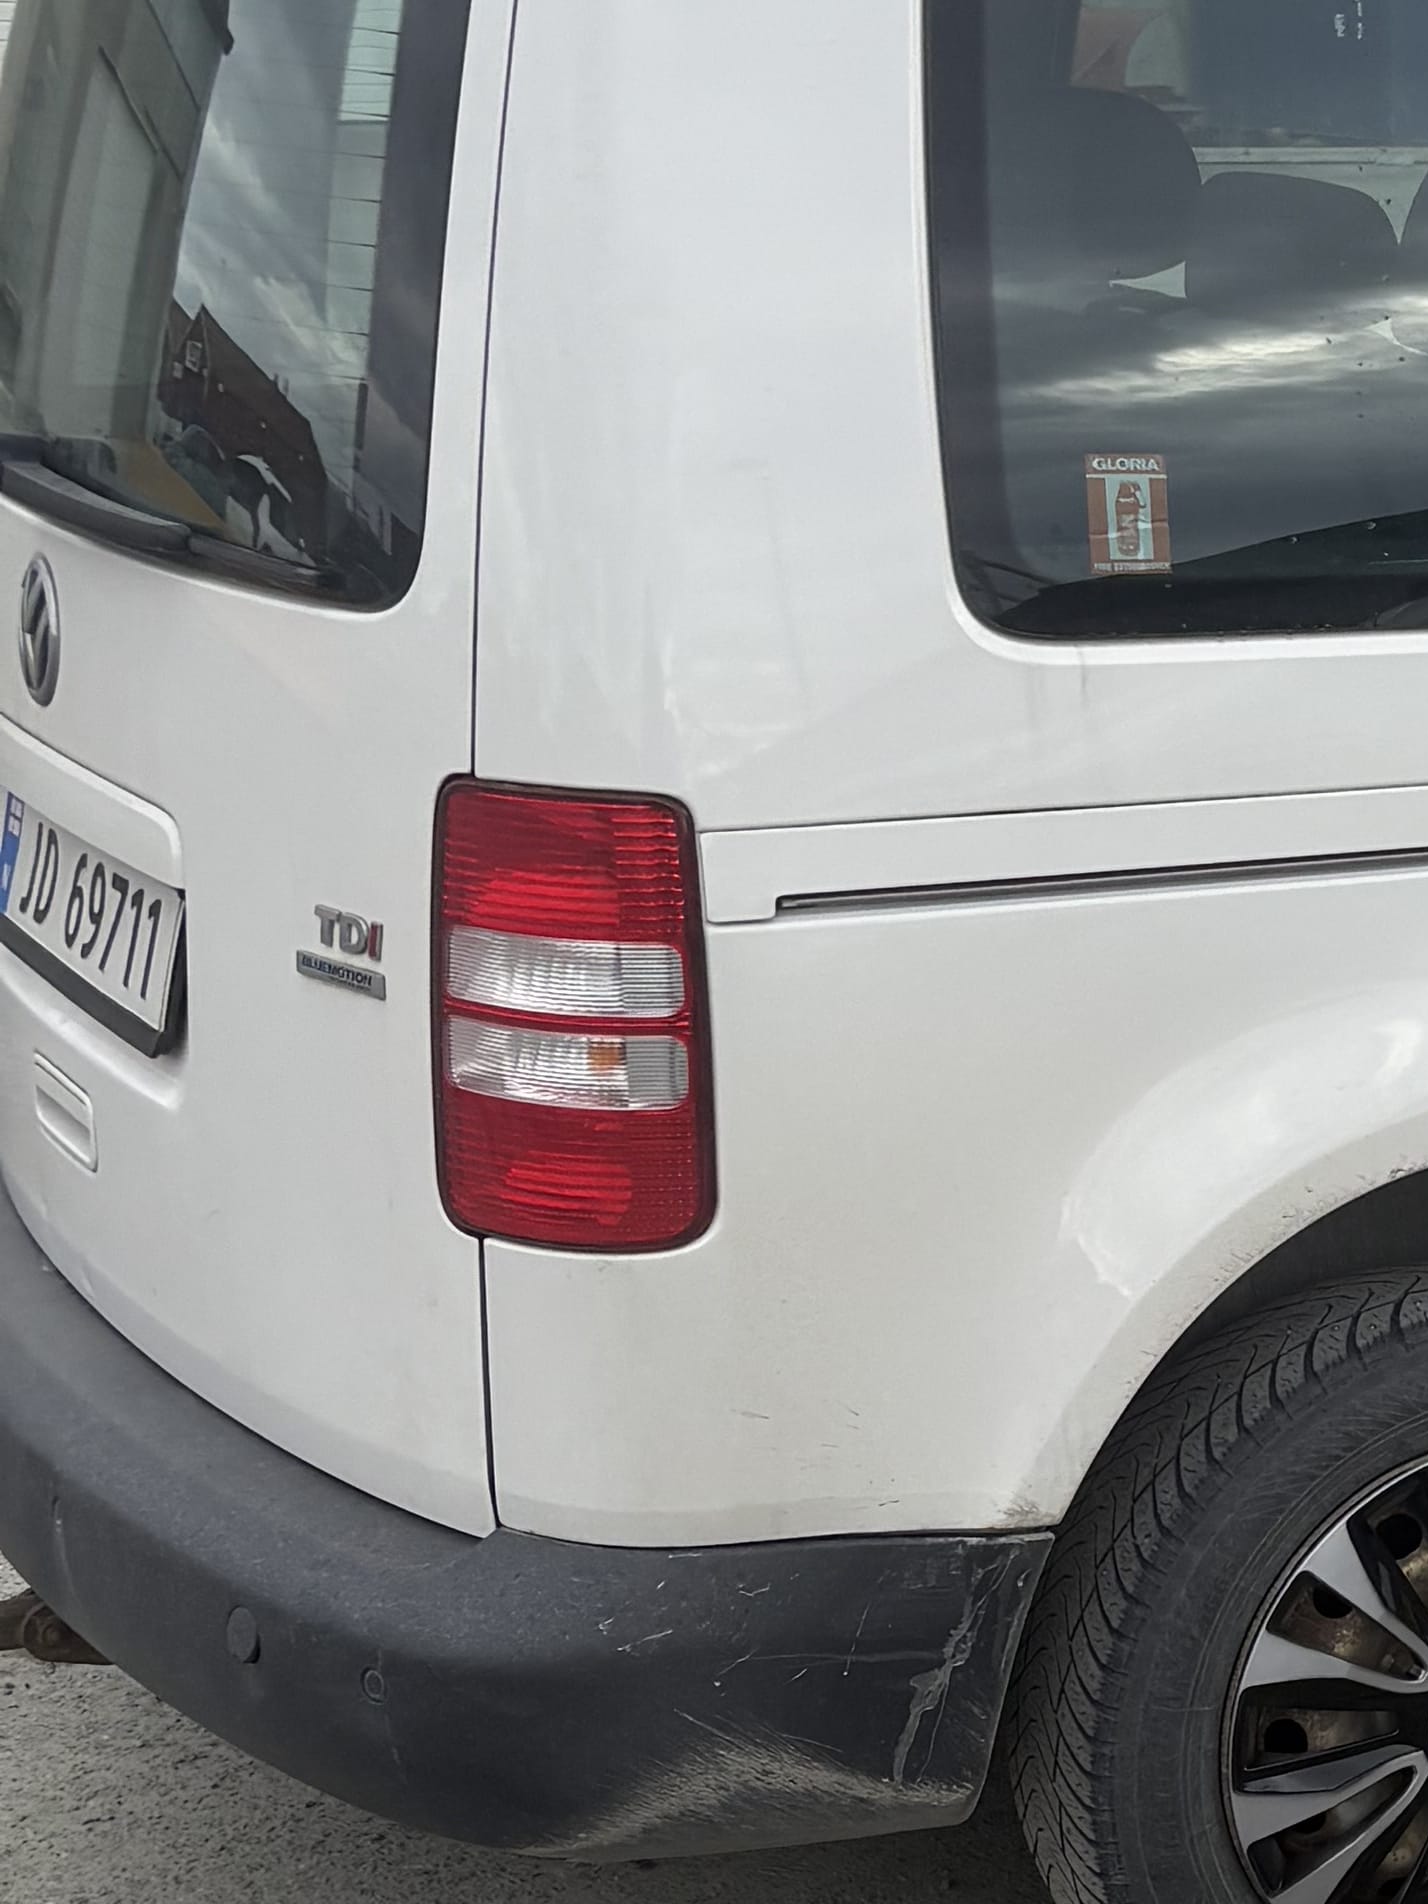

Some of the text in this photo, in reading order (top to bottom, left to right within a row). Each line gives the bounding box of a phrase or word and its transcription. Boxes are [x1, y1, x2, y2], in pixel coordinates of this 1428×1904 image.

[1092, 457, 1161, 471] GLORIA
[19, 821, 163, 1001] JD 69711
[313, 903, 384, 963] TDI
